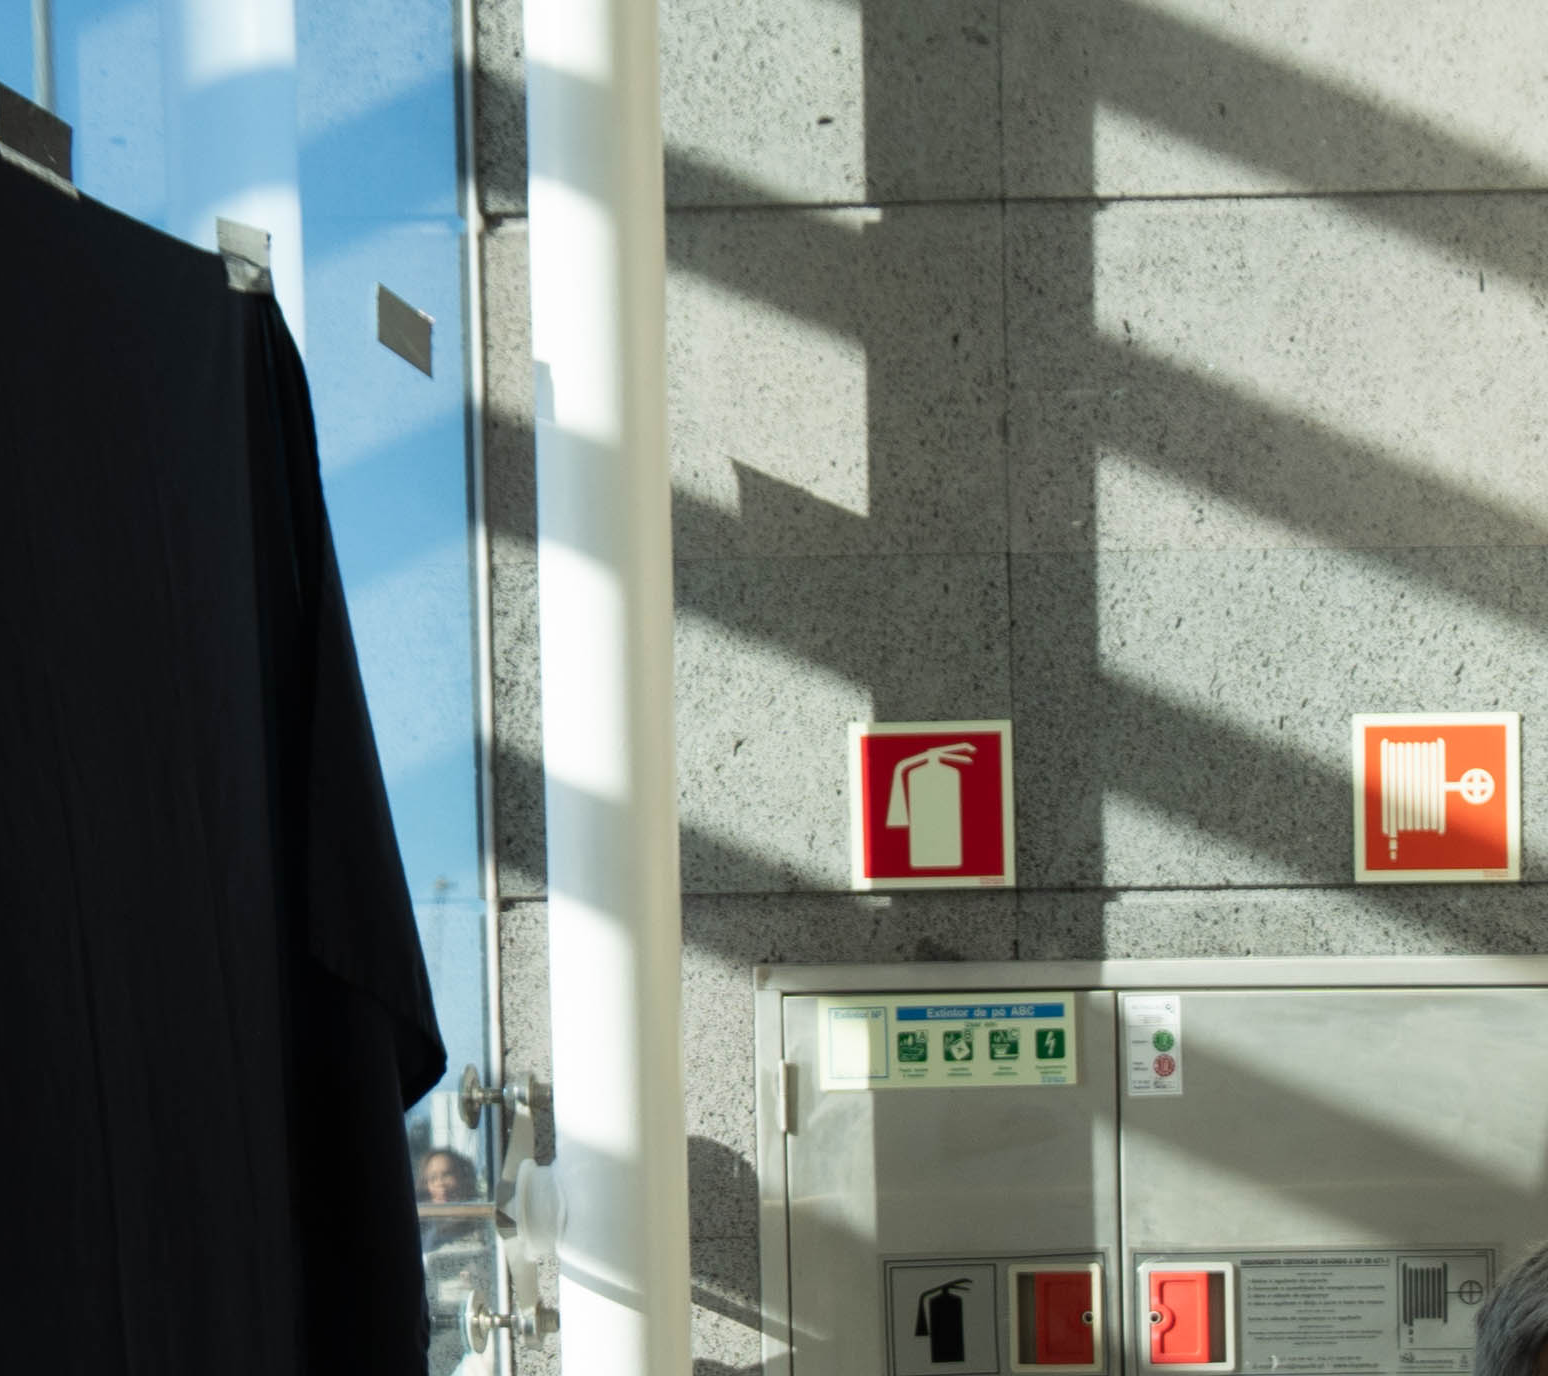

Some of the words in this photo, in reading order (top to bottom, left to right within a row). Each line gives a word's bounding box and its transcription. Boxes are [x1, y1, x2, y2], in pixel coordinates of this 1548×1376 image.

[926, 1006, 969, 1018] Extintor
[974, 1006, 987, 1017] de
[1011, 1005, 1035, 1017] ABC
